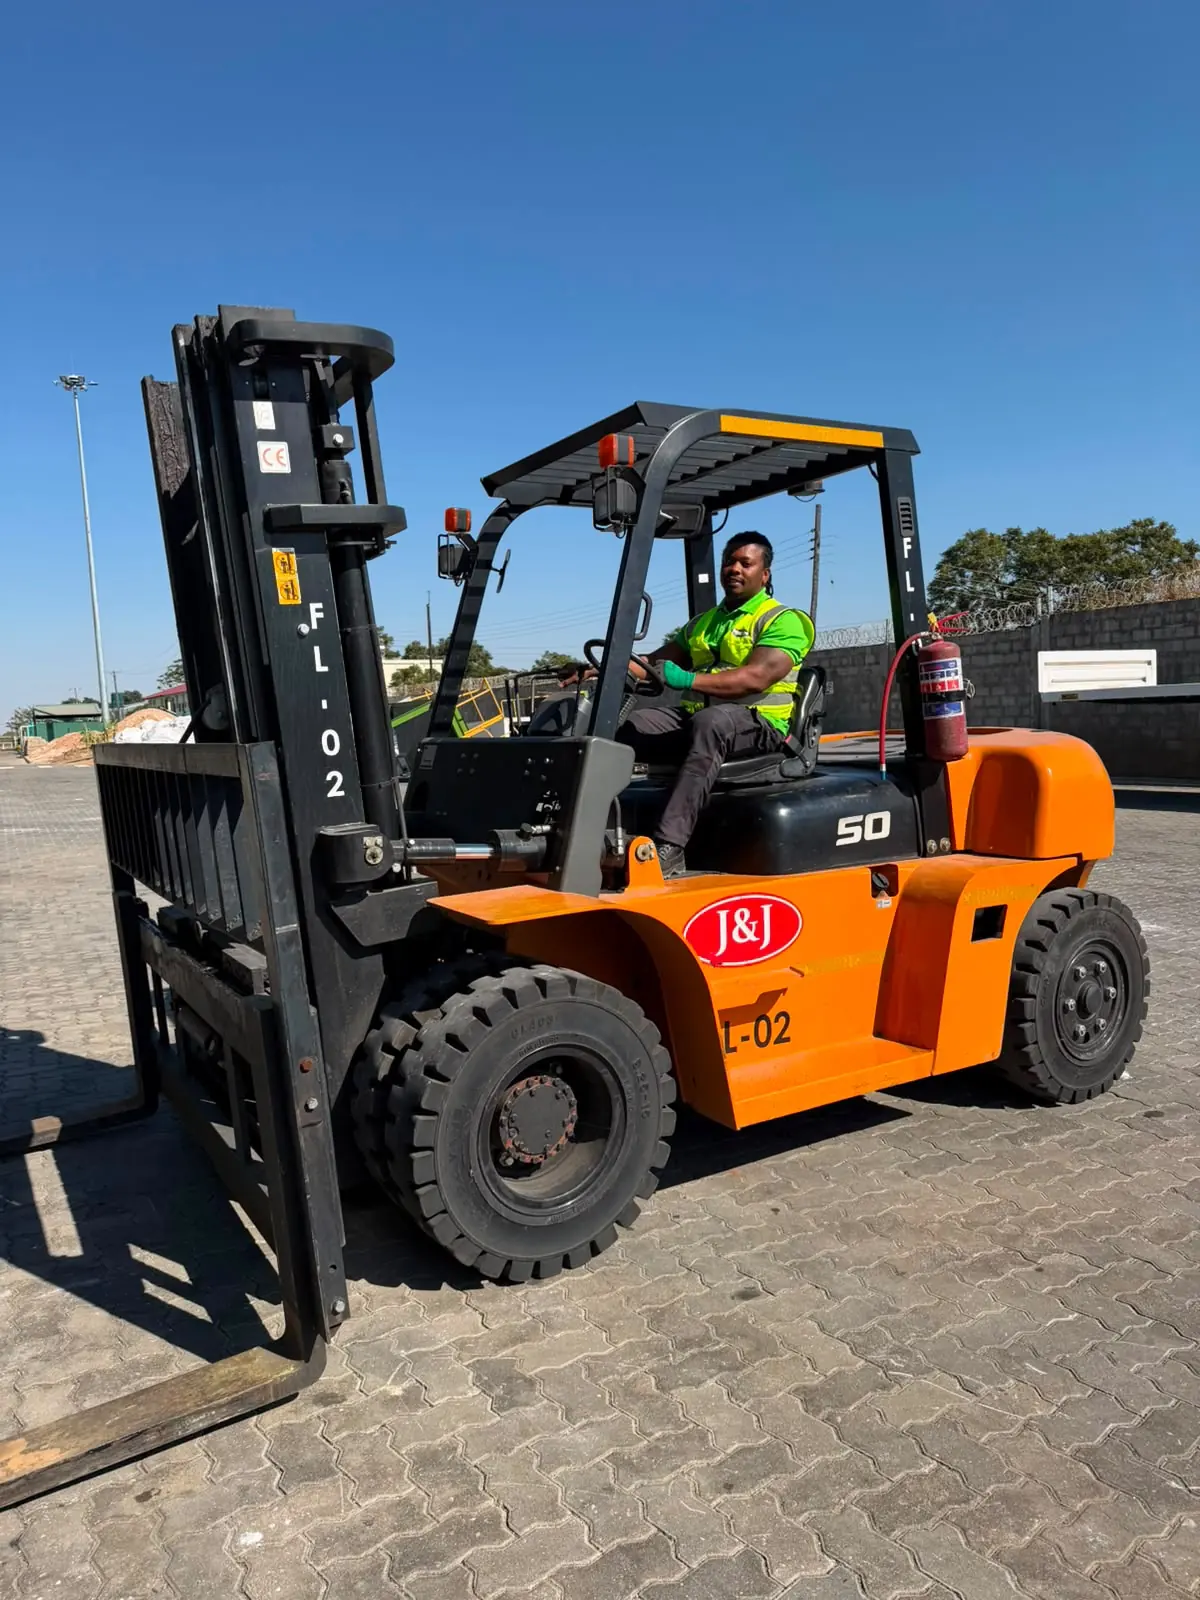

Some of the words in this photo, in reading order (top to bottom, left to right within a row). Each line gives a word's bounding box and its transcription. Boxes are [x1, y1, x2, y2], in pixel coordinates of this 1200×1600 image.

[262, 448, 287, 466] CE
[836, 811, 891, 847] 50
[715, 903, 773, 957] J&J
[724, 1011, 791, 1054] L-02
